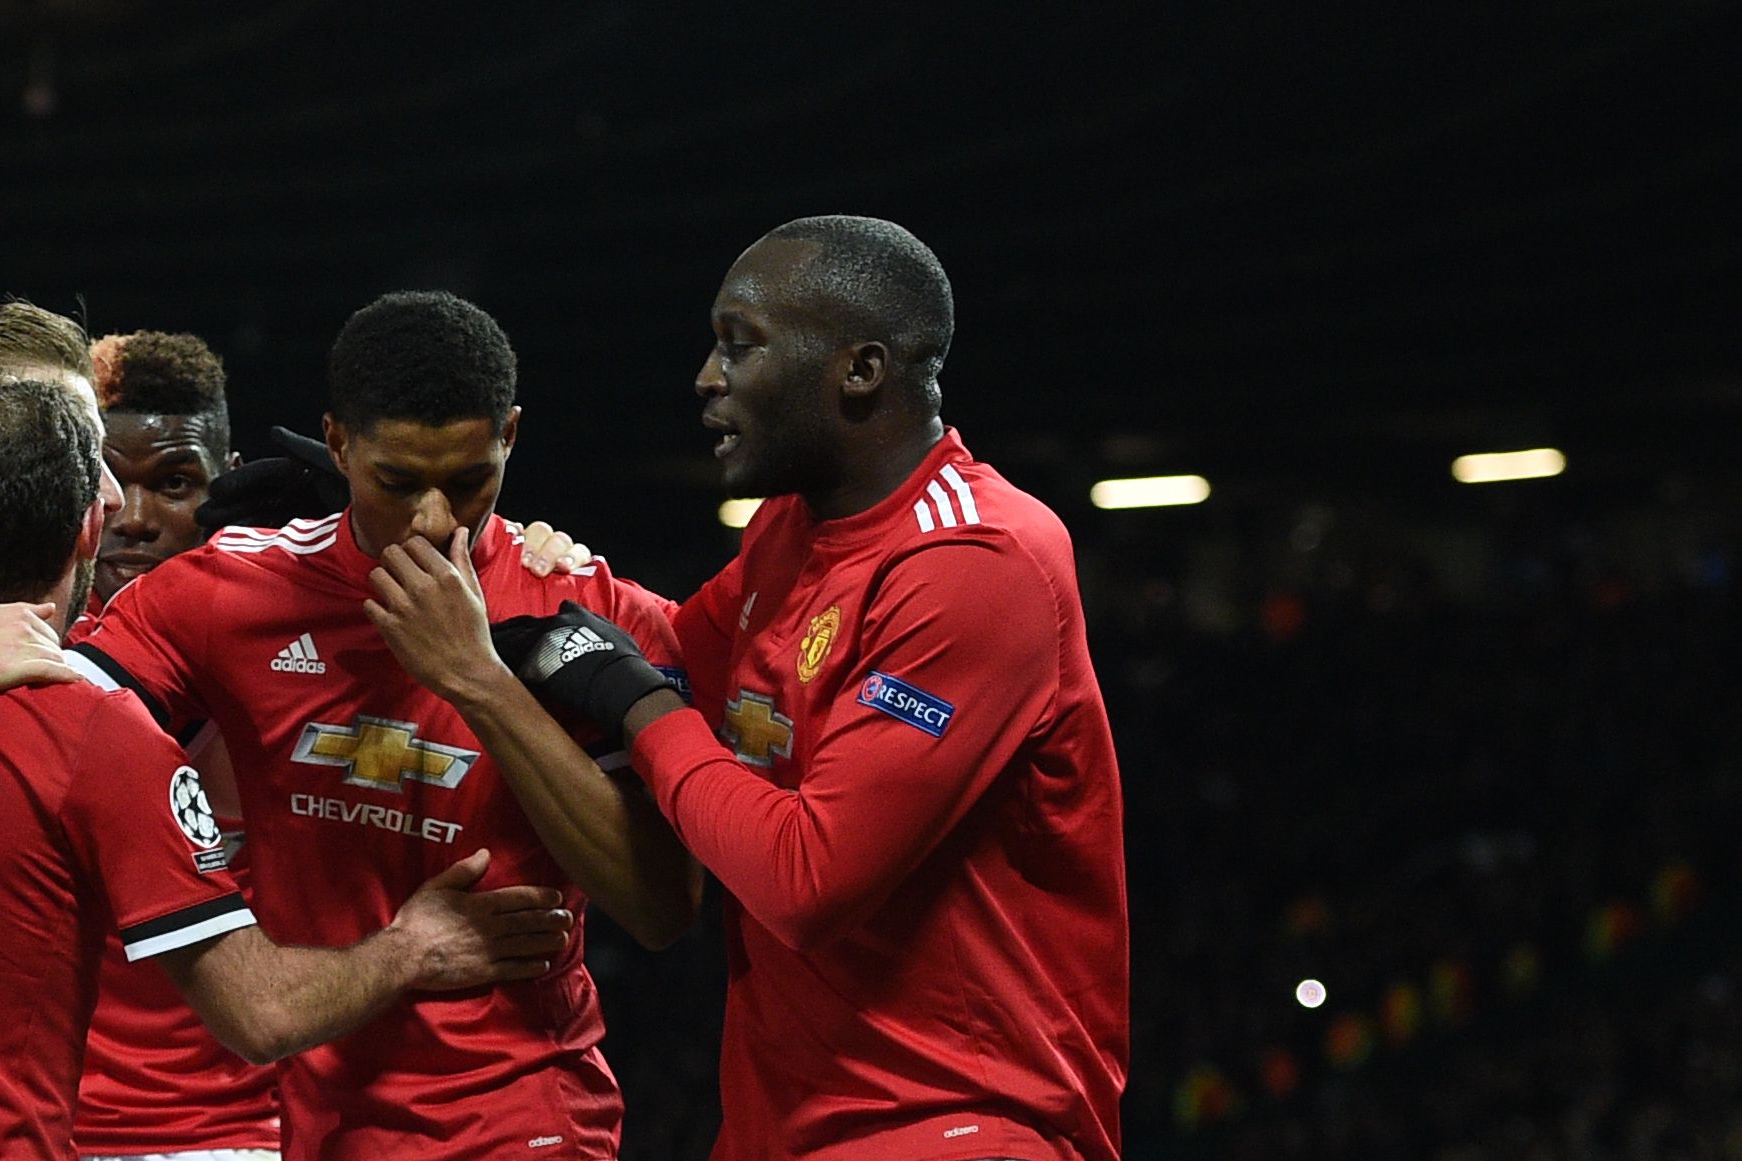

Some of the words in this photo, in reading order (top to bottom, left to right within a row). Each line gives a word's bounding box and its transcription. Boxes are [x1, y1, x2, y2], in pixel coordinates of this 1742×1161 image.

[270, 657, 326, 674] adidas
[560, 640, 615, 663] adidas
[877, 684, 950, 727] RESPECT
[291, 794, 463, 843] CHEVROLET
